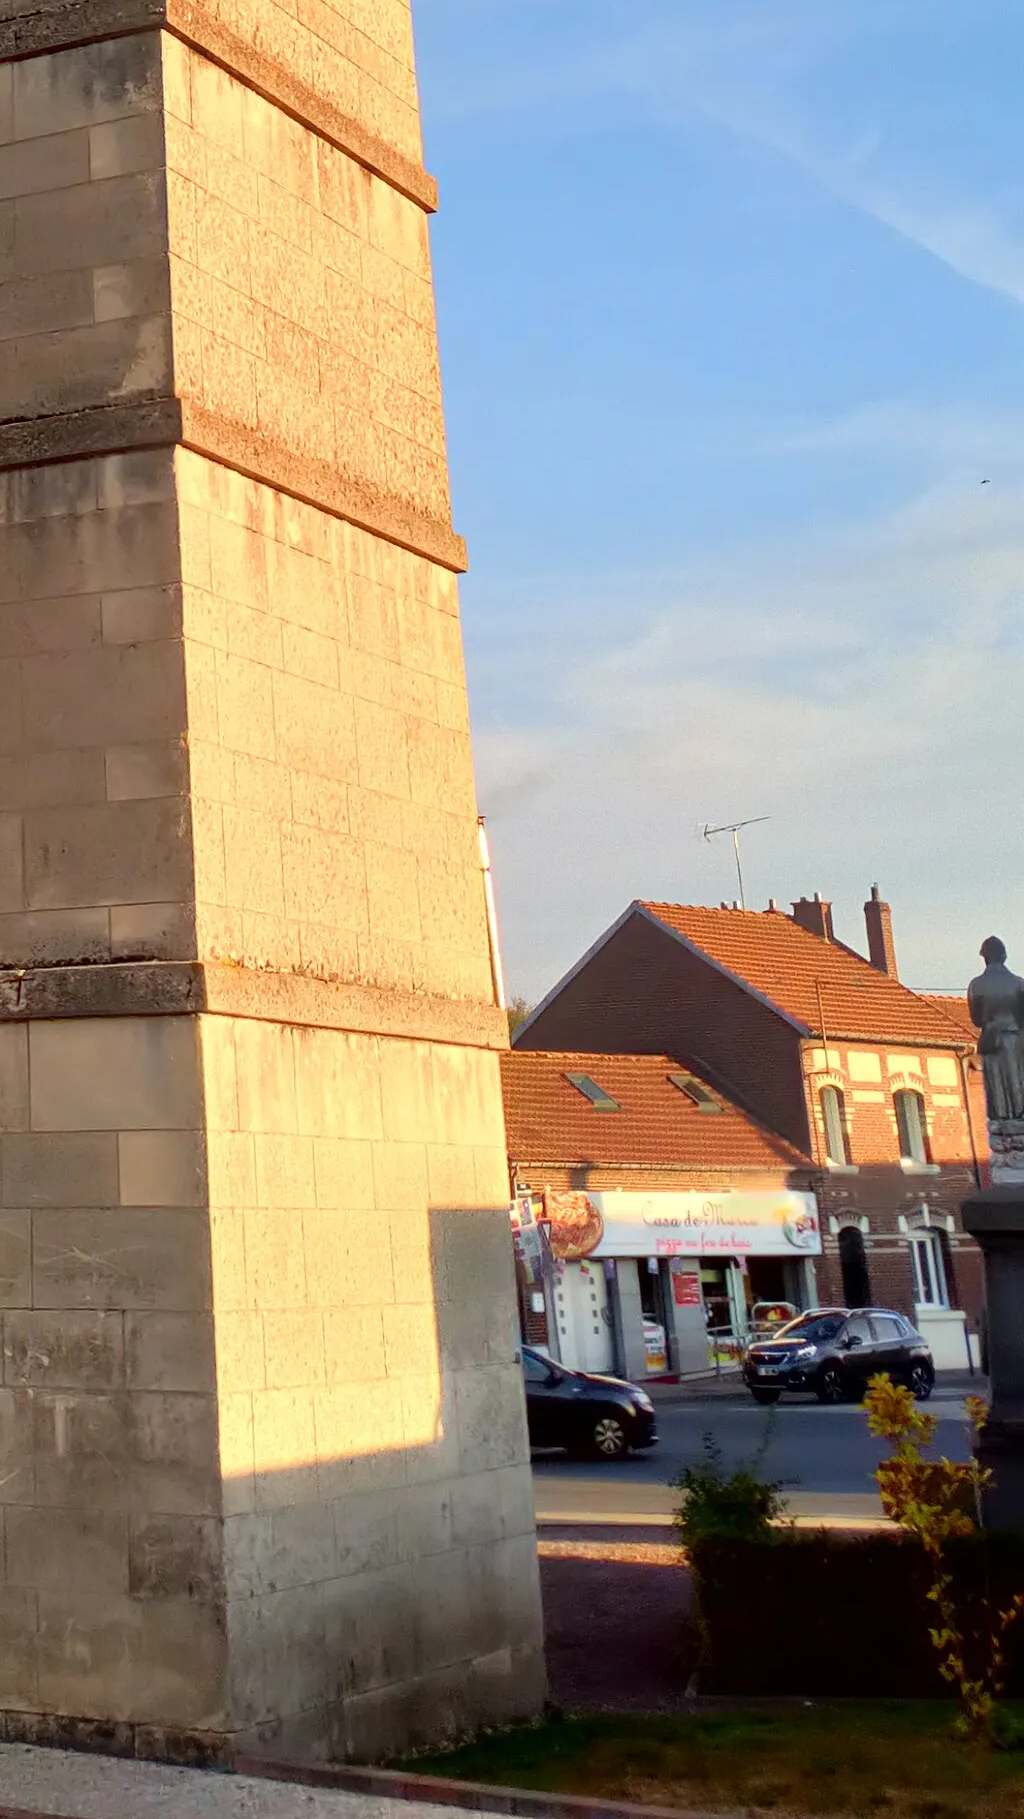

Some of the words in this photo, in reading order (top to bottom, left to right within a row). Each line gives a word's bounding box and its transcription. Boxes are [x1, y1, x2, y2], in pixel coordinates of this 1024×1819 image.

[641, 1200, 679, 1227] Casa
[684, 1209, 700, 1227] de
[655, 1236, 682, 1255] pizza
